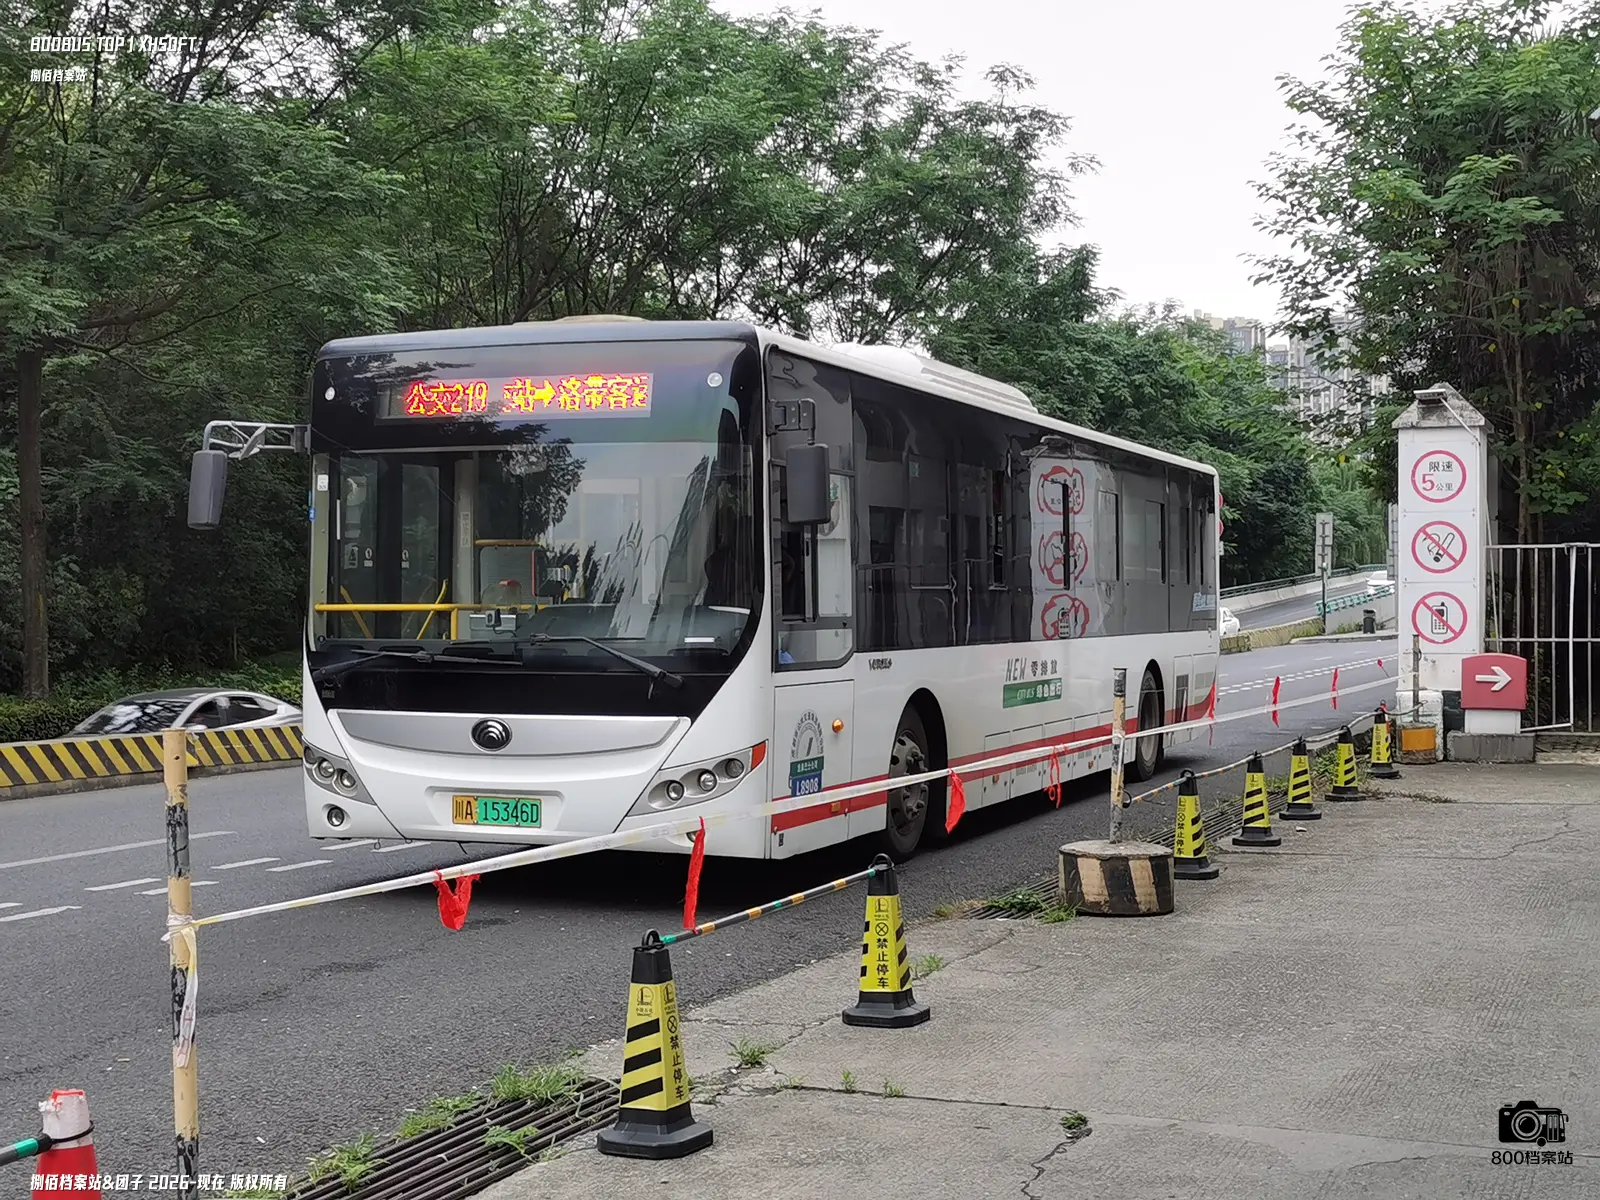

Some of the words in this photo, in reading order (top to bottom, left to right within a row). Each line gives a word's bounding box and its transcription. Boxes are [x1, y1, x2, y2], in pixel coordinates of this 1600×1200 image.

[1428, 460, 1454, 473] 限速
[795, 777, 819, 796] L8908
[876, 937, 889, 988] 禁止停车
[669, 1034, 684, 1100] 禁止停车
